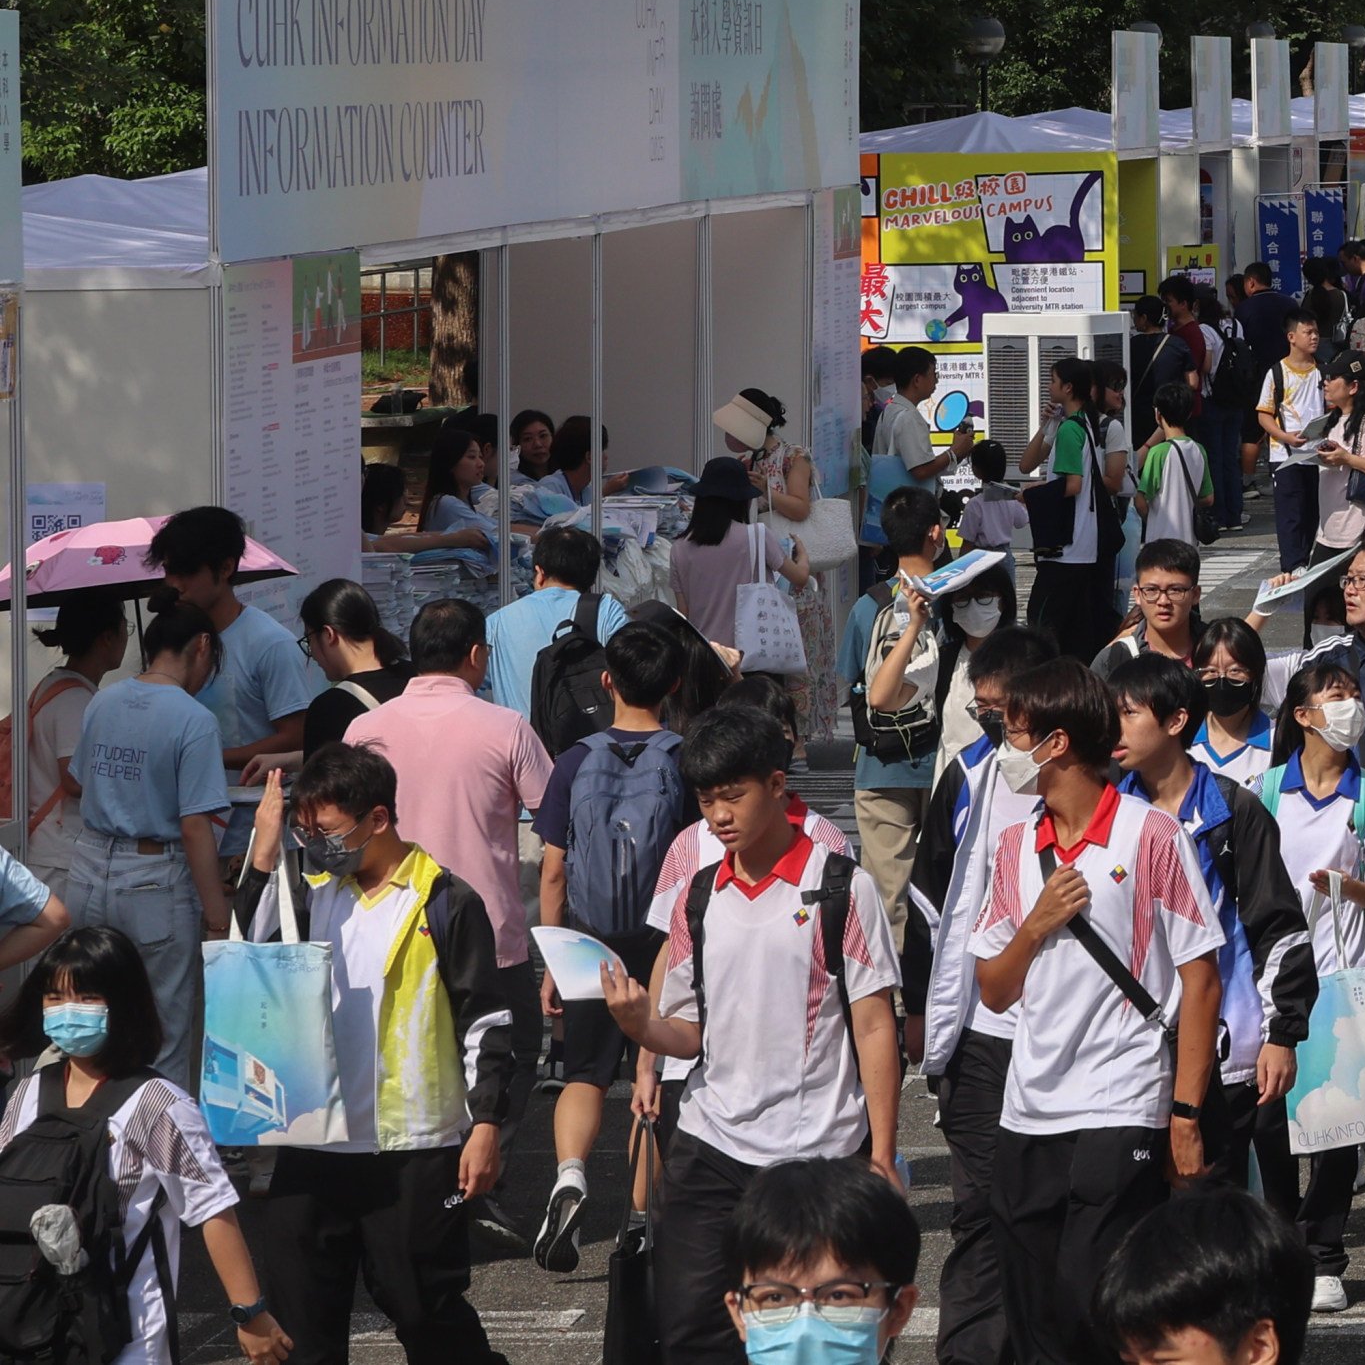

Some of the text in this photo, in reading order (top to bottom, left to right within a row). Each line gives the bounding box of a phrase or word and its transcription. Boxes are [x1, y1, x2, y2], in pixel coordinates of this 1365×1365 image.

[690, 81, 722, 140] 詢問處
[238, 99, 485, 197] INFORMATION COUNTER
[884, 194, 1054, 231] MARVELOUS CAMPUS
[1265, 223, 1282, 291] 聯合書院
[1011, 276, 1049, 285] 位置方便
[1011, 285, 1075, 294] Convenient location
[860, 263, 889, 333] 最大
[895, 292, 951, 302] 校園面積最大
[1011, 294, 1039, 303] adjacent
[895, 302, 917, 311] Largest
[1011, 302, 1084, 312] University MTR station
[965, 372, 980, 380] MTR
[943, 477, 954, 485] bus
[91, 743, 147, 764] STUDENT
[90, 761, 141, 781] HELPER
[1298, 1129, 1332, 1147] CUHK
[1333, 1120, 1365, 1140] INFO
[1133, 1148, 1150, 1161] QOS
